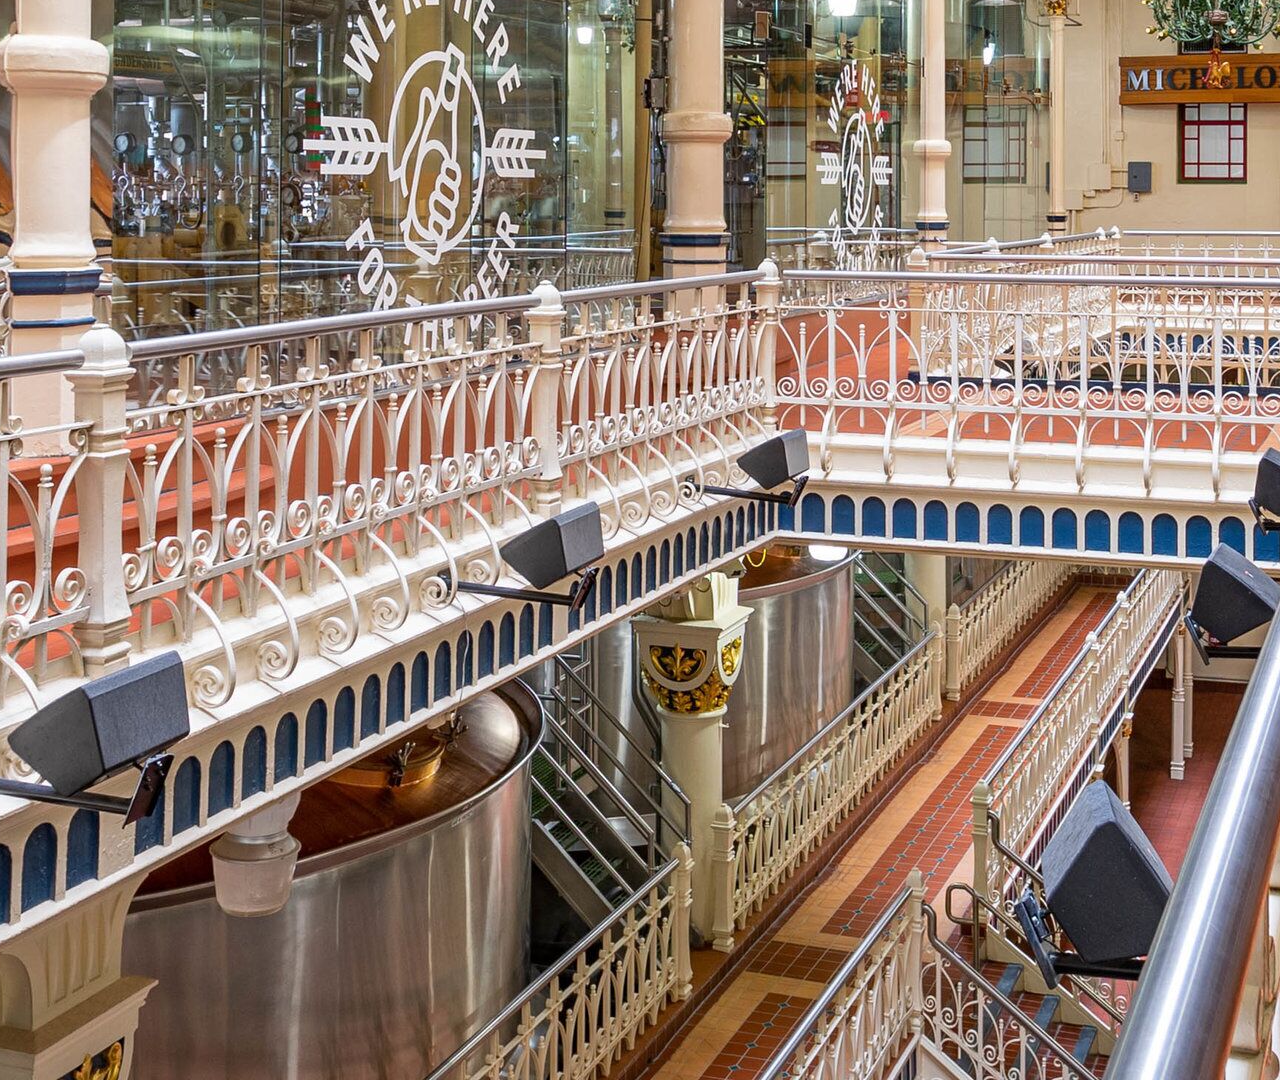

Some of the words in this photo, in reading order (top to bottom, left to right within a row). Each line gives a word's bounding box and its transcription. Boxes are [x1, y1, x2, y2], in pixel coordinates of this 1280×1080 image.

[827, 59, 858, 134] WE'RE
[861, 63, 886, 142] HERE
[345, 217, 398, 312] FOR
[463, 210, 521, 332] BEER
